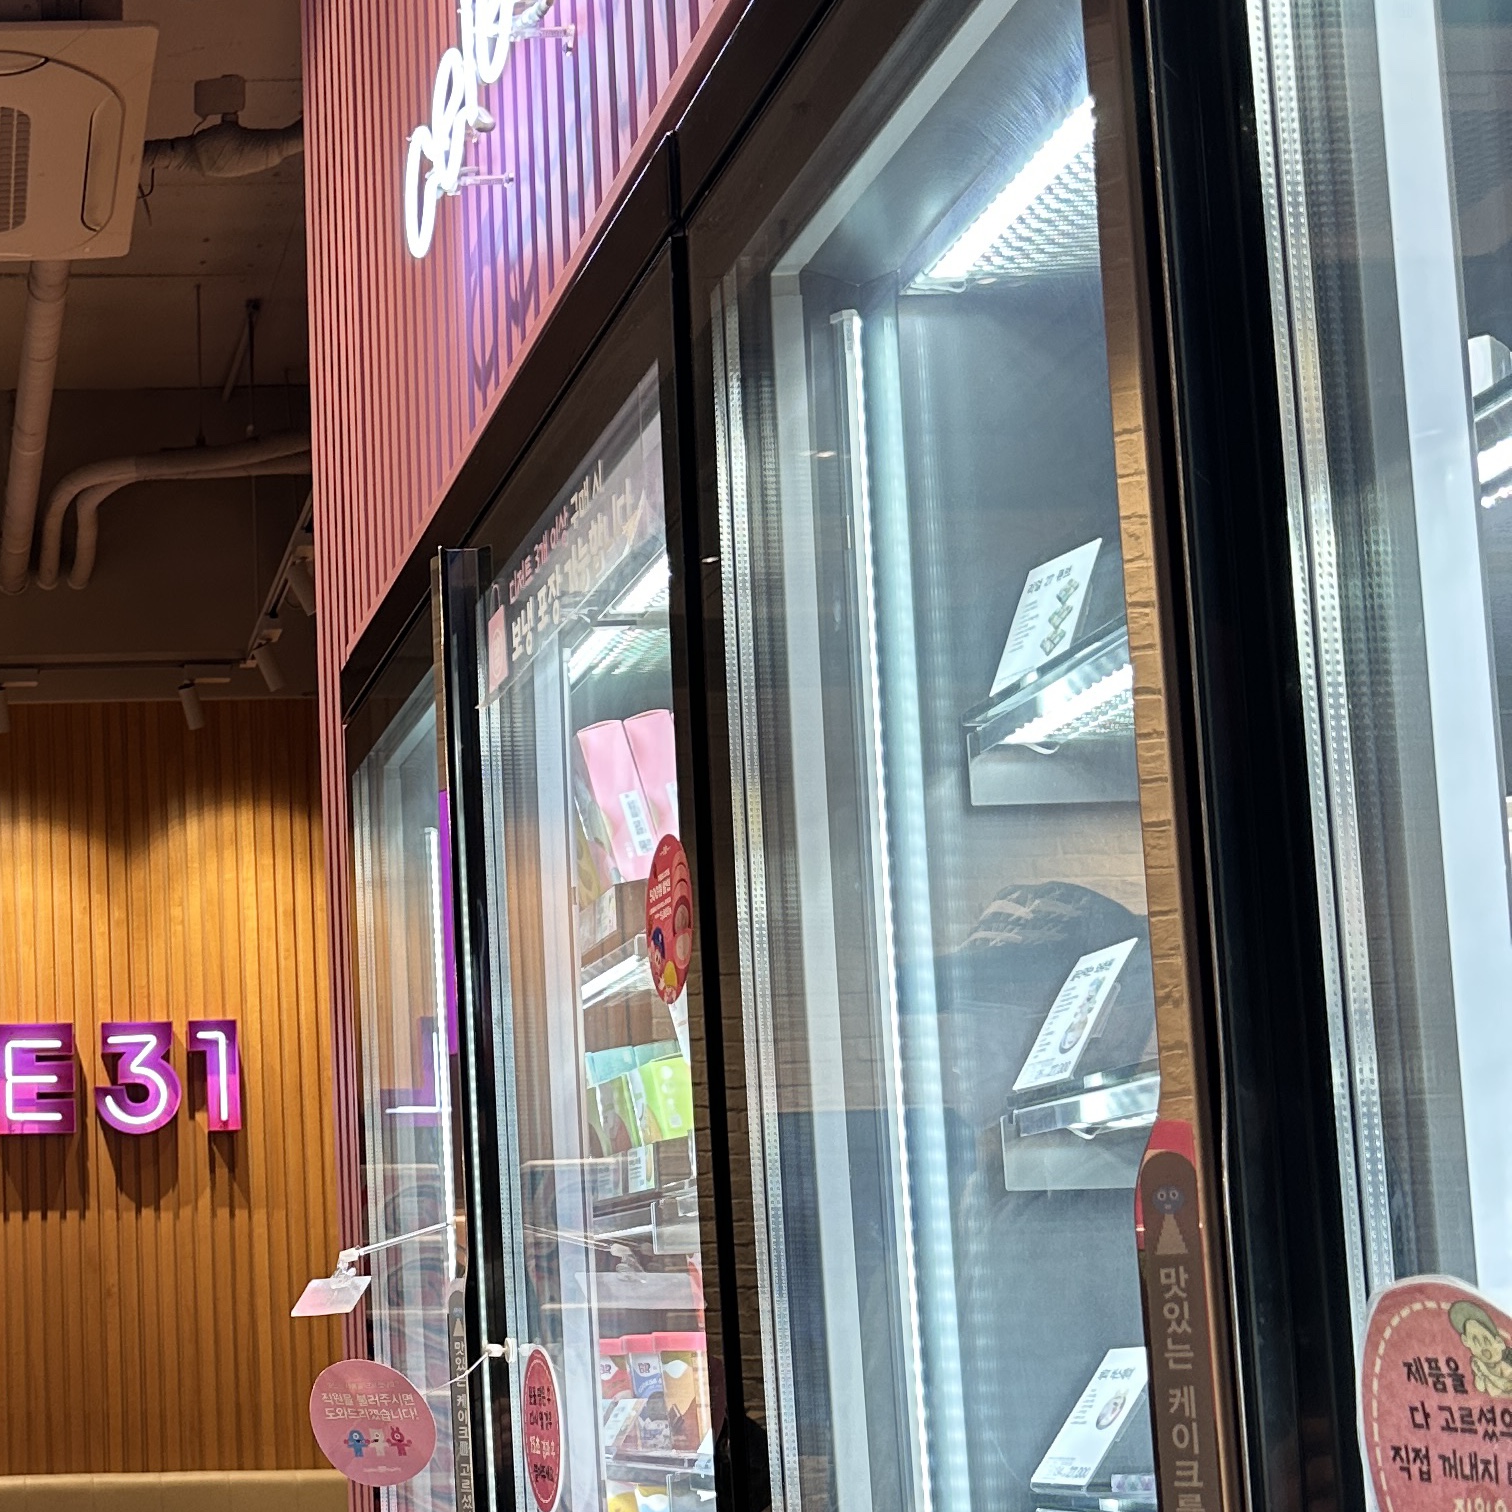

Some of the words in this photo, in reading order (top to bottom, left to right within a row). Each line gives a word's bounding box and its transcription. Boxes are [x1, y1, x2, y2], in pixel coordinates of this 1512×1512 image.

[509, 554, 534, 604] 디저트
[550, 505, 569, 549] 이상
[511, 595, 535, 662] 보냉
[537, 563, 563, 631] 포장
[1158, 1266, 1194, 1371] 맛있는
[453, 1341, 467, 1388] 맛있는
[1402, 1355, 1468, 1395] 제품을
[321, 1392, 354, 1406] 직원을
[356, 1392, 415, 1407] 불러주시면
[325, 1407, 420, 1422] 도와드리겠습니다!
[1409, 1400, 1431, 1431] 다
[456, 1393, 471, 1457] 케이크를
[1391, 1444, 1432, 1483] 직접
[1437, 1449, 1500, 1486] 꺼내지
